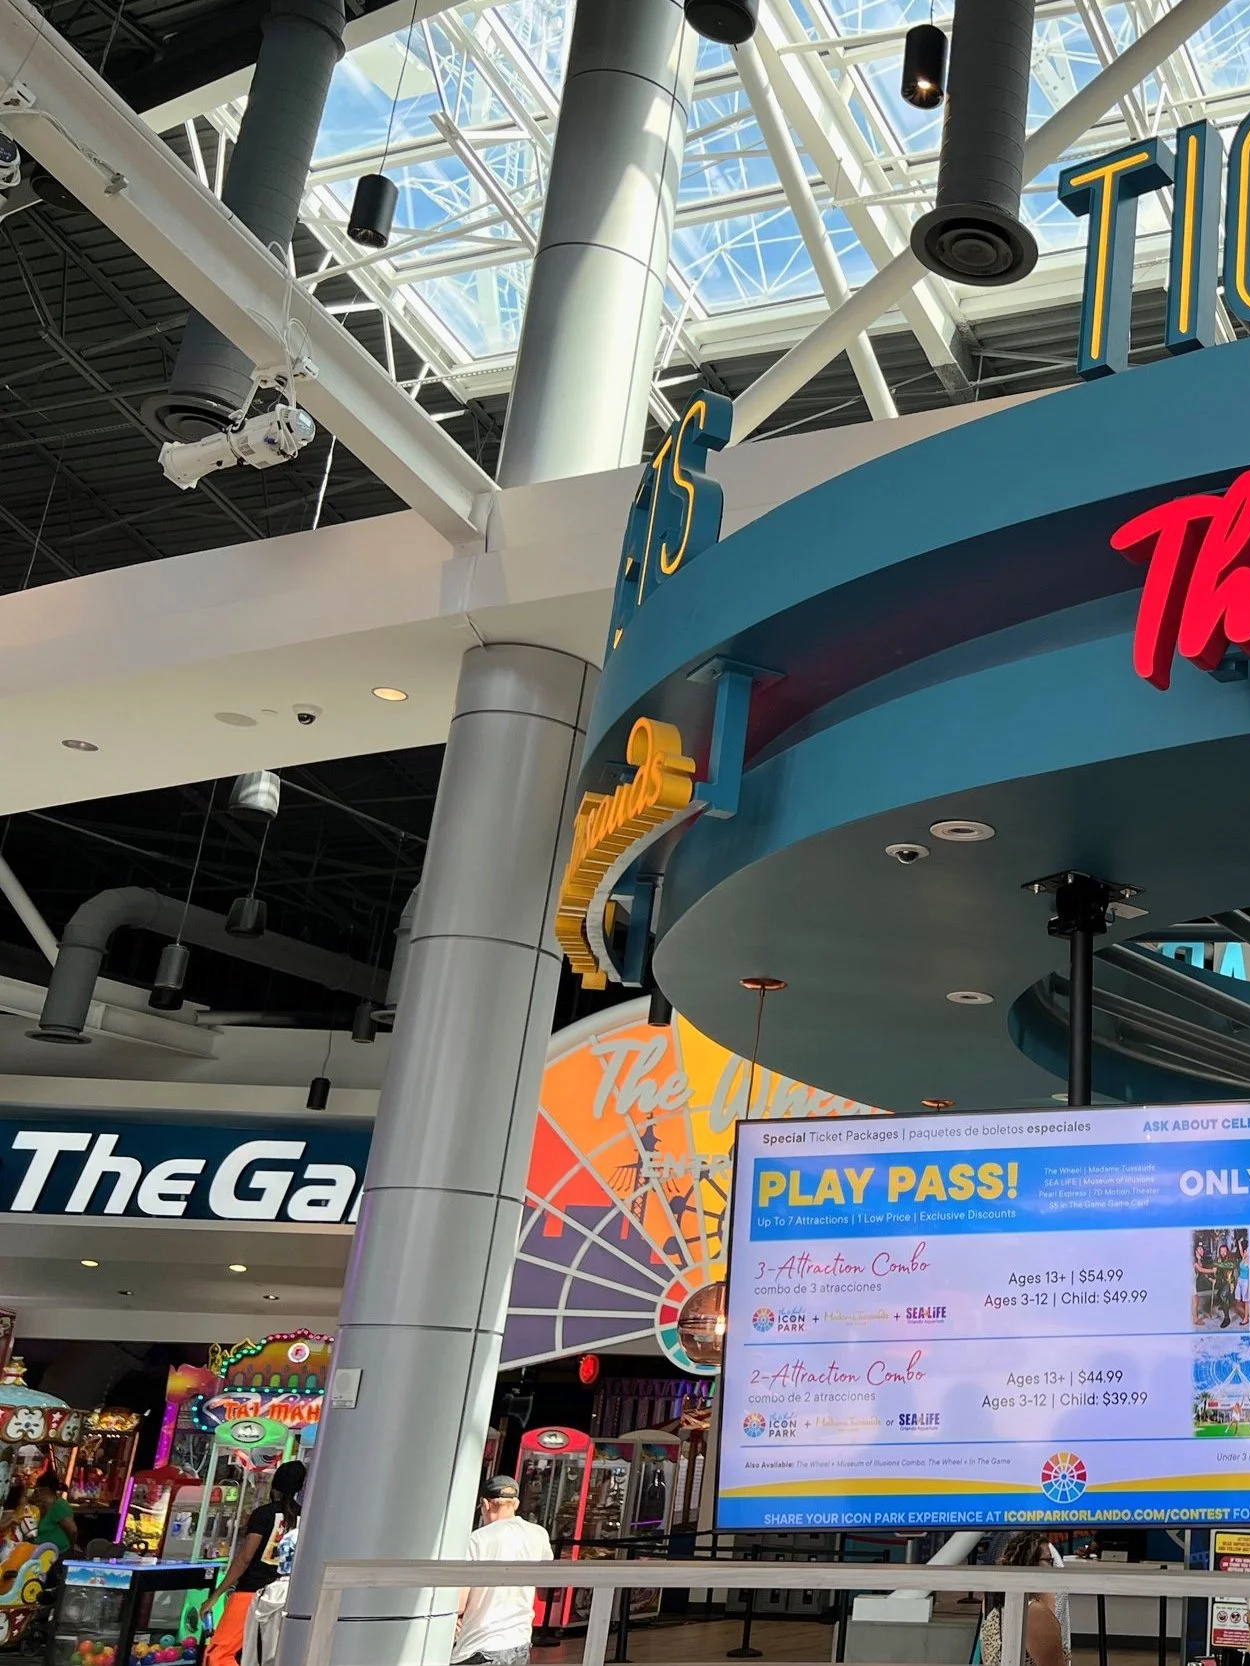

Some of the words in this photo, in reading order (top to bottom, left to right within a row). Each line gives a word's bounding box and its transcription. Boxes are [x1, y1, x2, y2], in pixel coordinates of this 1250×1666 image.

[590, 1034, 694, 1119] The
[763, 1132, 806, 1145] Special
[809, 1131, 842, 1143] Ticket
[846, 1129, 899, 1143] Packages
[908, 1126, 961, 1141] paquetes
[964, 1124, 979, 1137] de
[982, 1122, 1024, 1135] boletos
[1027, 1121, 1091, 1135] especiales
[1143, 1119, 1169, 1132] ASK
[1172, 1117, 1218, 1131] ABOUT
[10, 1130, 207, 1217] The
[208, 1140, 364, 1224] Ga
[758, 1167, 875, 1208] PLAY
[888, 1162, 1019, 1202] PASS!
[757, 1216, 771, 1228] Up
[773, 1216, 786, 1227] To
[788, 1216, 793, 1226] 7
[795, 1213, 849, 1226] Attractions
[863, 1213, 886, 1223] Low
[887, 1211, 911, 1222] Price
[919, 1209, 966, 1222] Exclusive
[967, 1208, 1017, 1220] Discounts
[754, 1251, 865, 1282] 3-Attraction
[871, 1241, 930, 1277] Combo
[1008, 1272, 1041, 1287] Ages
[1046, 1271, 1066, 1283] 13+
[1079, 1268, 1124, 1283] $54.99
[754, 1285, 791, 1296] combo
[793, 1283, 807, 1294] de
[810, 1282, 817, 1293] 3
[820, 1282, 882, 1293] atracciones
[984, 1294, 1017, 1309] Ages
[1021, 1293, 1048, 1305] 3-12
[1061, 1291, 1100, 1305] Child:
[1103, 1289, 1147, 1305] $49.99
[777, 1315, 806, 1324] ICON
[777, 1324, 806, 1332] PARK
[750, 1359, 860, 1391] 2-Attraction
[866, 1350, 926, 1386] Combo
[1006, 1373, 1040, 1387] Ages
[1044, 1372, 1065, 1384] 13+
[1078, 1370, 1123, 1384] $44.99
[748, 1393, 785, 1404] combo
[787, 1392, 801, 1403] de
[804, 1392, 811, 1402] 2
[814, 1391, 876, 1402] atracciones
[982, 1395, 1015, 1410] Ages
[1019, 1394, 1047, 1406] 3-12
[1060, 1393, 1099, 1406] Child:
[1102, 1391, 1148, 1406] $39.99
[769, 1420, 797, 1429] ICON
[769, 1429, 797, 1438] PARK
[764, 1513, 803, 1525] SHARE
[805, 1513, 839, 1525] YOUR
[840, 1512, 872, 1524] ICON
[874, 1512, 906, 1524] PARK
[908, 1511, 984, 1524] EXPERIENCE
[985, 1511, 1001, 1523] AT
[1004, 1508, 1230, 1523] ICONPARKORLANDO.COM/CONTEST
